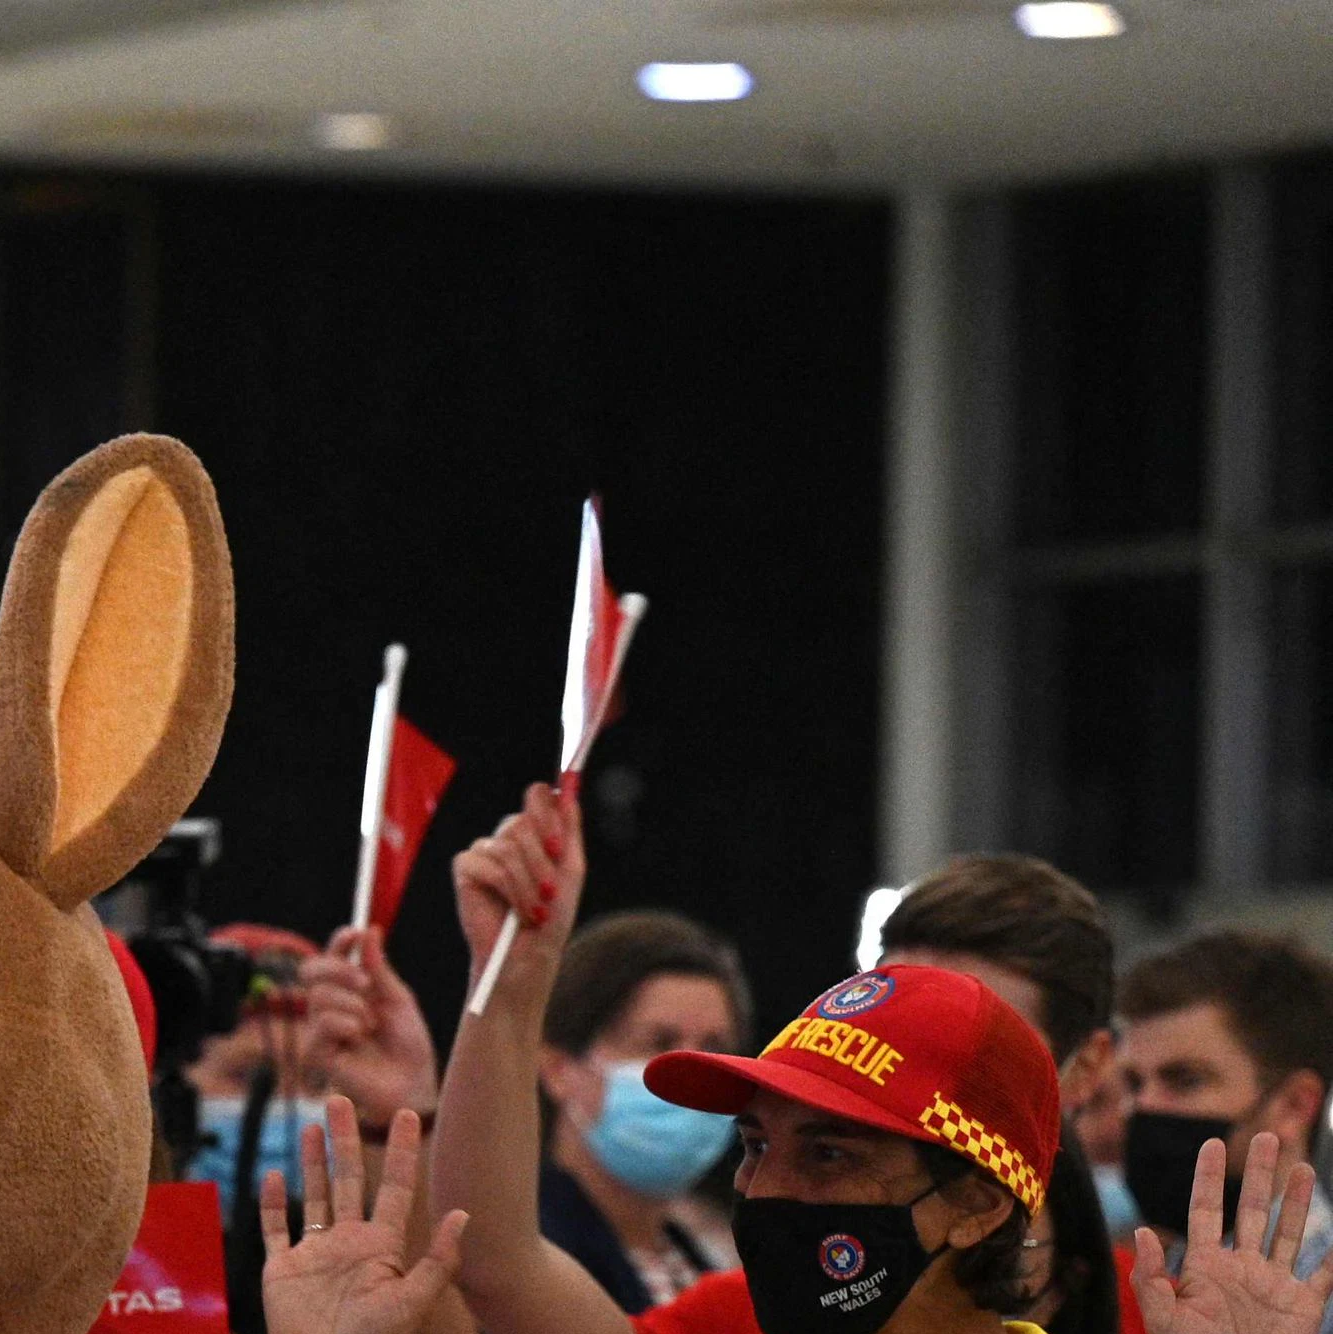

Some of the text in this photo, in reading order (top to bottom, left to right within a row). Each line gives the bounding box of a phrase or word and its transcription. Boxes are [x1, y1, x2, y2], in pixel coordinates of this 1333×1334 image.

[791, 1018, 905, 1087] RESCUE
[107, 1286, 183, 1315] TAS
[819, 1267, 889, 1308] NEW SOUTH
[839, 1287, 882, 1312] WALES
